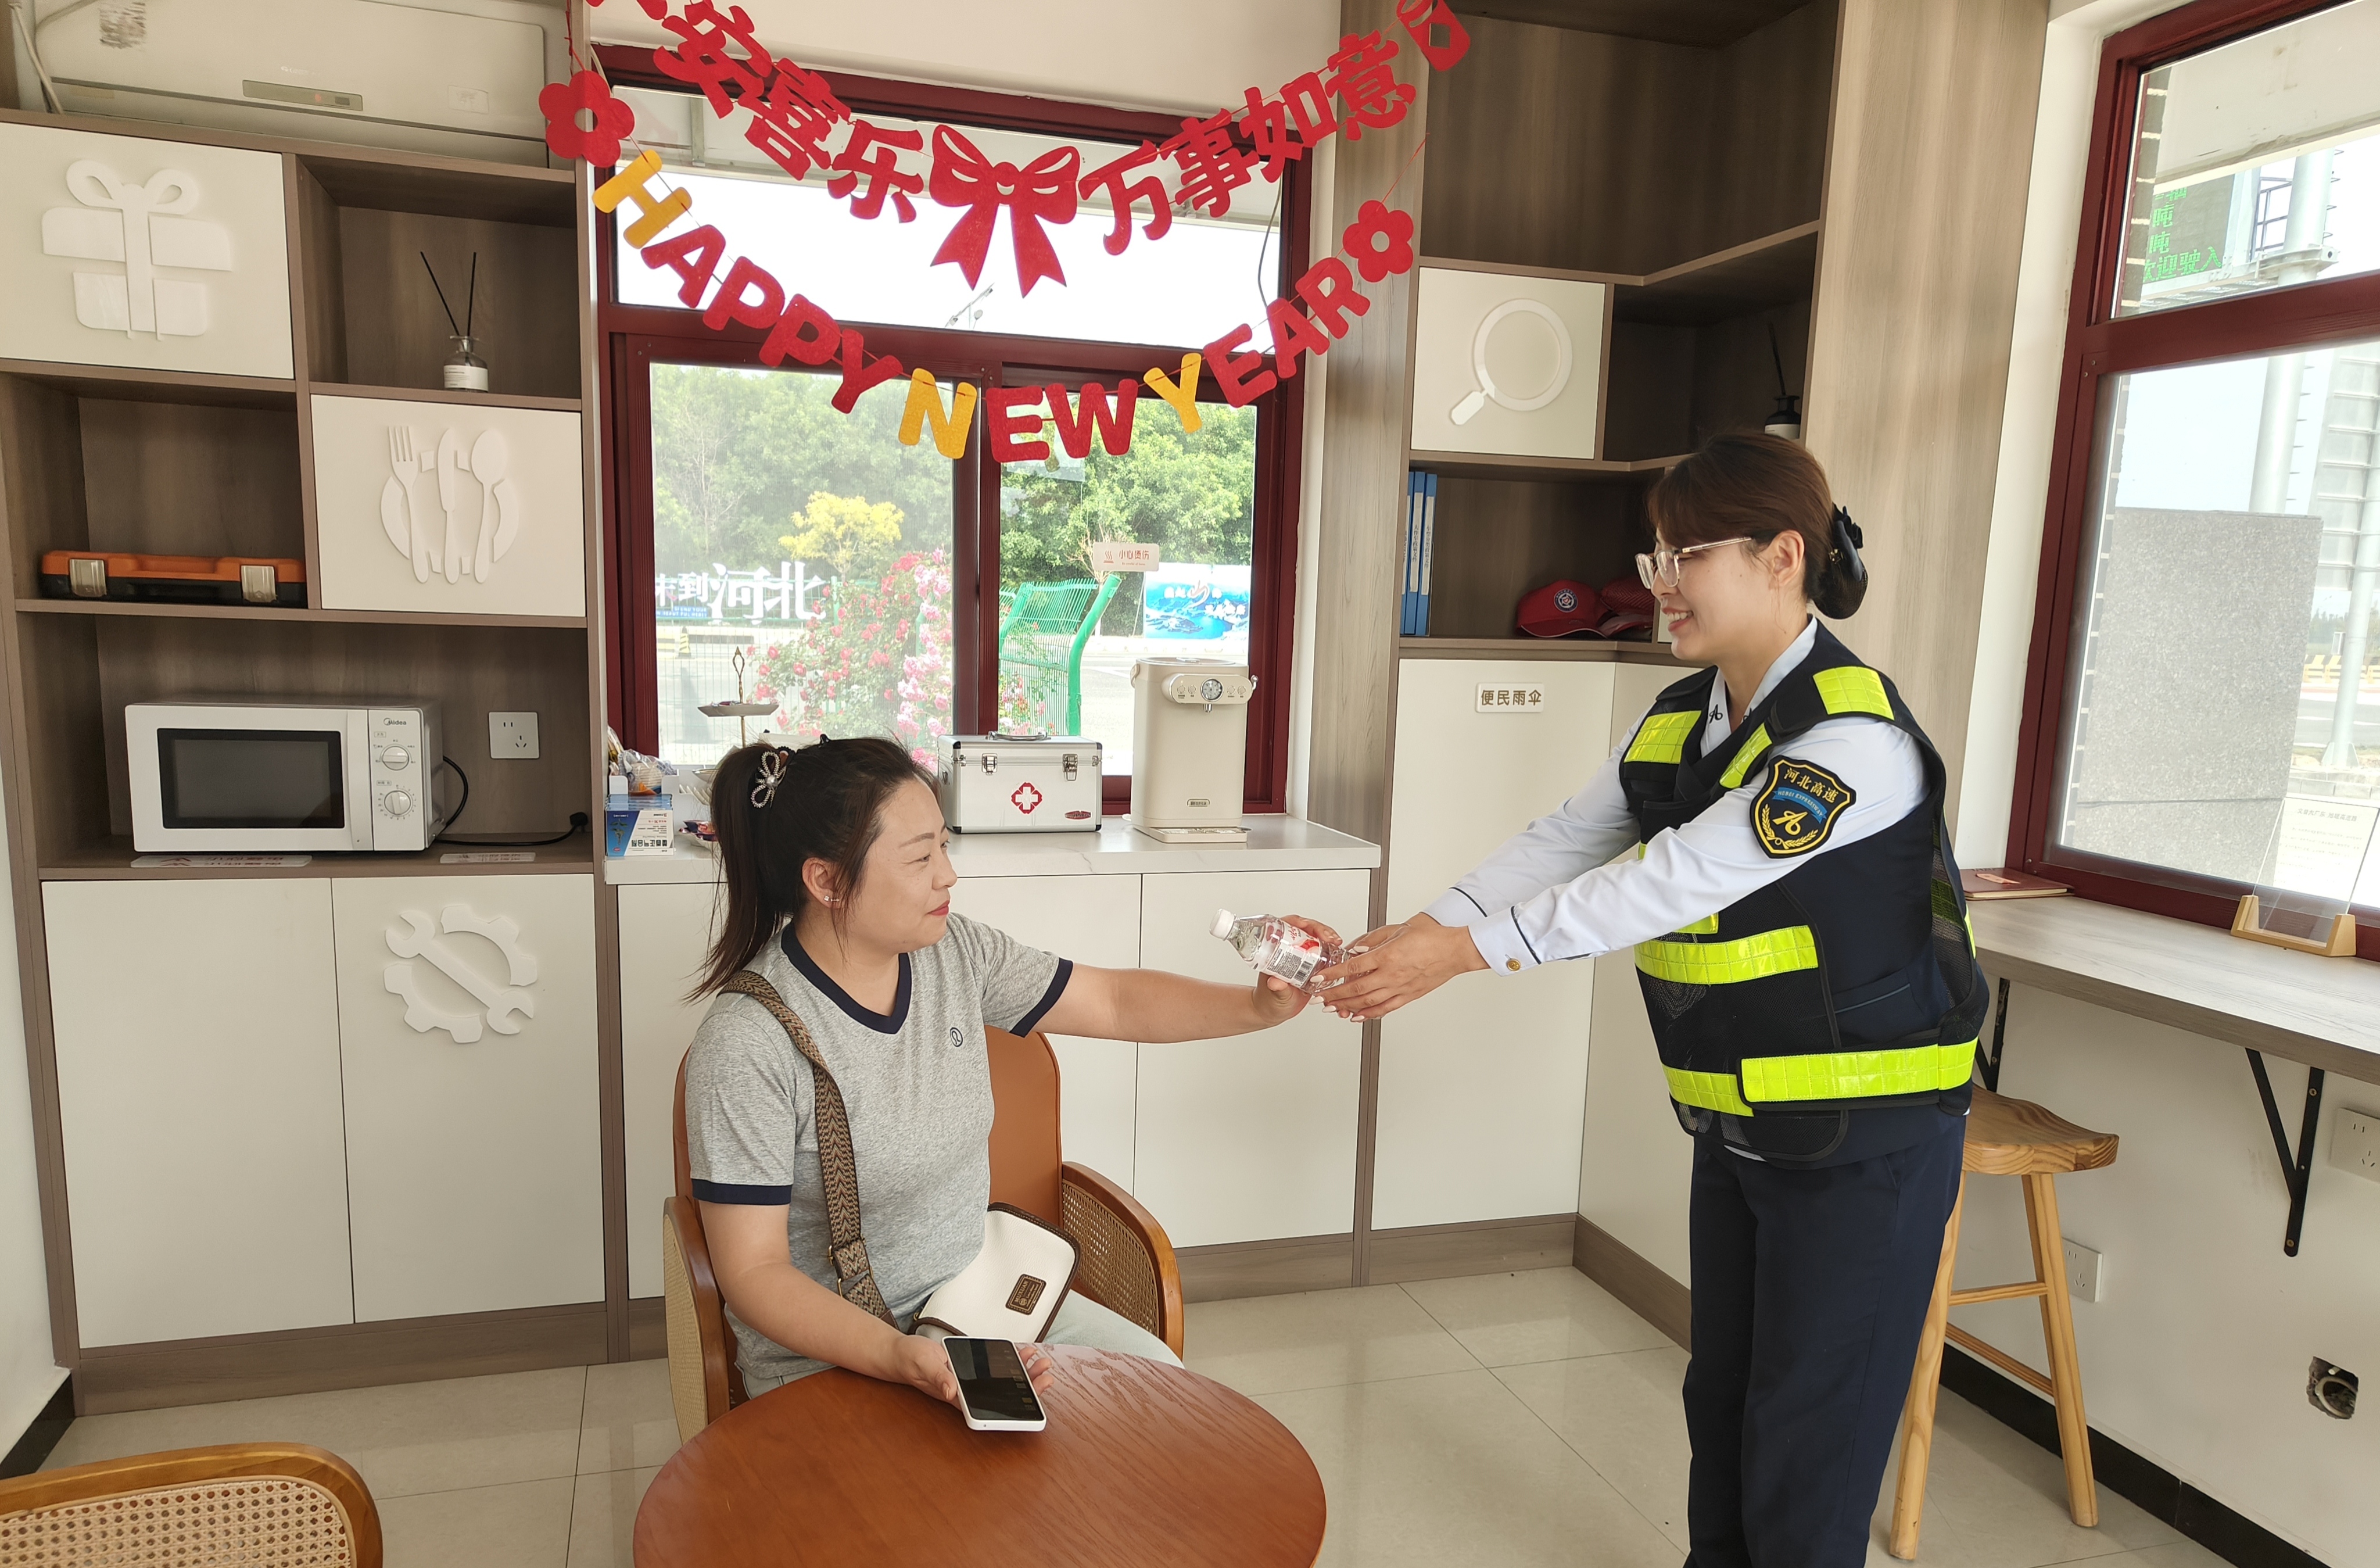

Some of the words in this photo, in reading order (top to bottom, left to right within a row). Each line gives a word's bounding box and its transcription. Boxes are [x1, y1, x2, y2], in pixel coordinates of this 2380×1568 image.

[586, 0, 924, 224] 好喜乐
[1078, 30, 1416, 256] 万事如意
[592, 149, 903, 414] HAPPY
[898, 368, 1138, 463] NEW
[1144, 257, 1370, 434] YEAR
[1119, 549, 1149, 560] 小心烫伤
[1481, 689, 1542, 707] 便民雨伞
[1784, 767, 1839, 803] 河北高速
[1795, 793, 1823, 817] EXPRESSWAY
